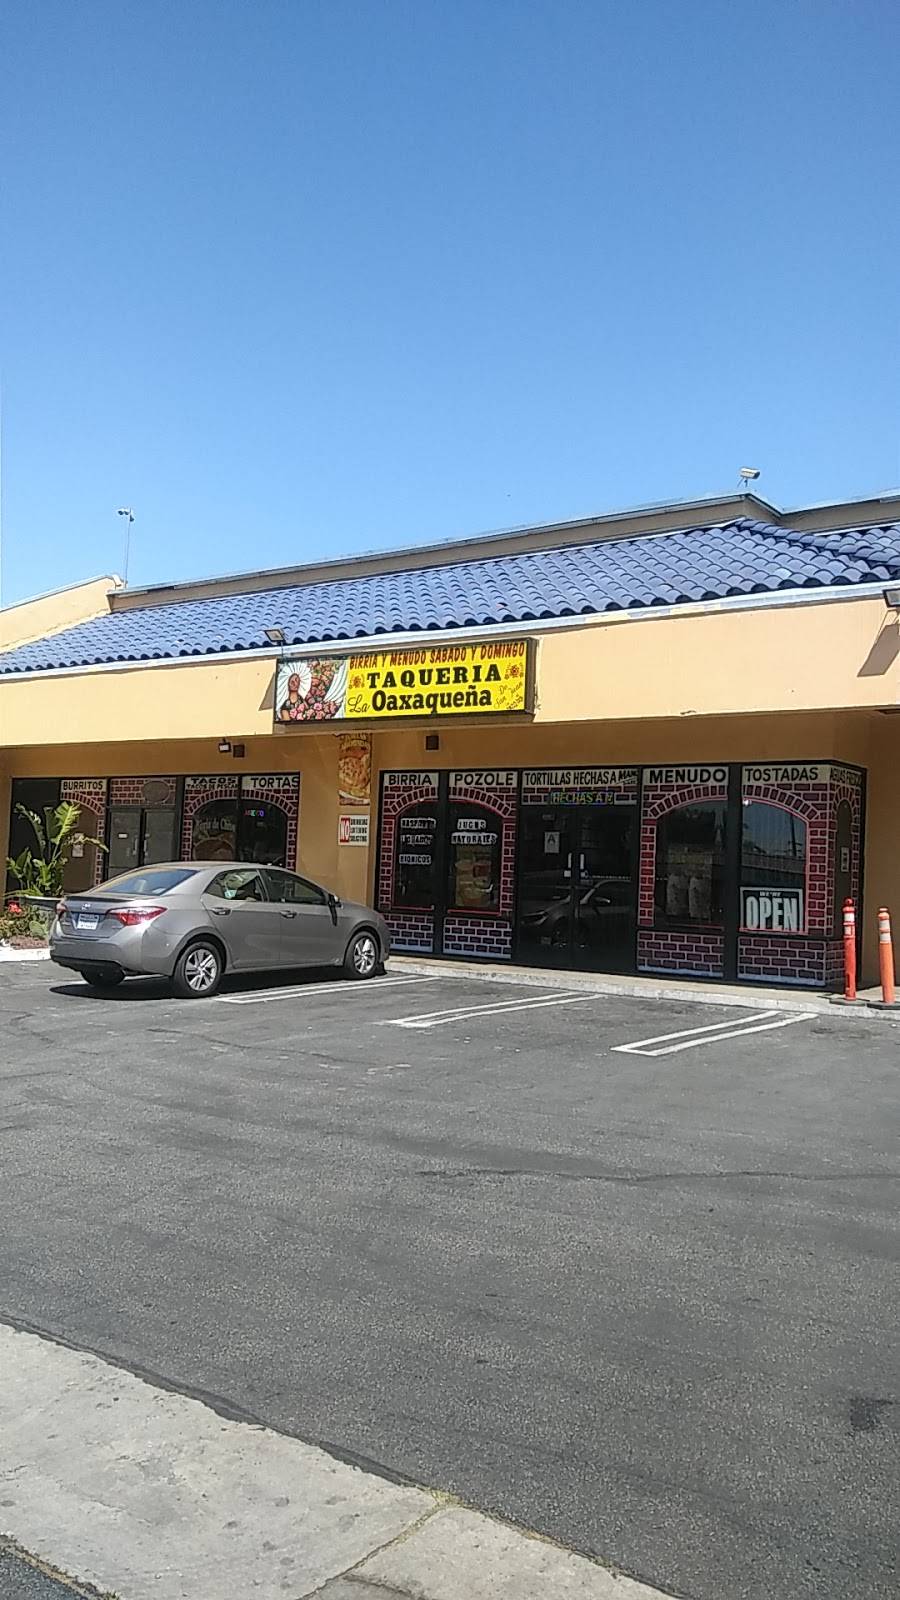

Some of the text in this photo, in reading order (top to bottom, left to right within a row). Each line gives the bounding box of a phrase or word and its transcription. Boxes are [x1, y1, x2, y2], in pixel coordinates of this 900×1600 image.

[350, 642, 525, 670] BIRRIA Y MENUDO SABADO Y DOMINGO
[367, 664, 501, 689] TAQUERIA
[348, 694, 370, 713] La
[372, 685, 492, 714] Oaxaqueña
[190, 777, 237, 785] TACOS
[388, 774, 433, 786] BIRRIA
[454, 773, 514, 785] POZOLE
[524, 772, 571, 786] TORTILLAS
[573, 771, 609, 785] HECHAS
[609, 771, 617, 784] A
[649, 768, 727, 784] MENUDO
[744, 767, 819, 782] TOSTADAS
[63, 780, 103, 791] BURRITOS
[250, 776, 300, 789] TORTAS
[553, 792, 594, 803] HECHAS
[746, 896, 798, 932] OPEN
